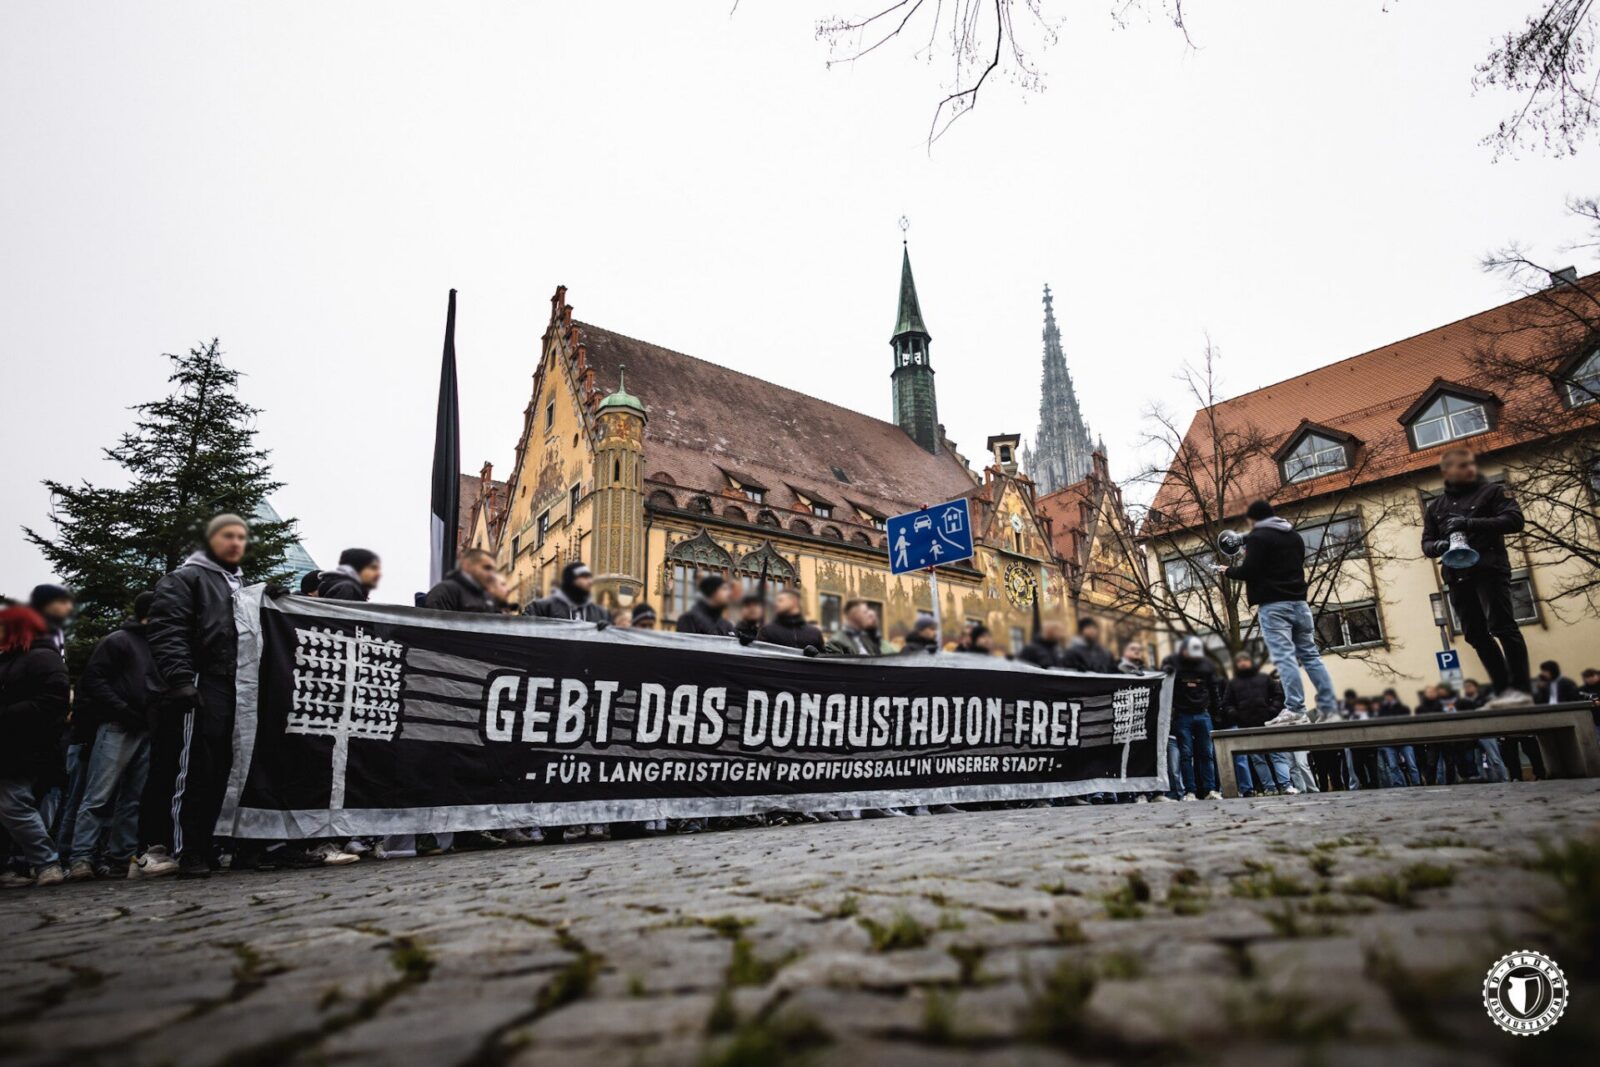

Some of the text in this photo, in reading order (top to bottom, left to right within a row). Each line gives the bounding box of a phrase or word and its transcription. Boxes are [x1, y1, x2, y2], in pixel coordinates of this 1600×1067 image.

[1440, 653, 1454, 668] P
[485, 675, 1082, 747] GEBT DAS DONAUSTADION FREI
[545, 754, 591, 784] FÜR
[599, 761, 772, 783] LANGFRISTIGEN
[776, 760, 912, 781] PROFIFUSSBALL
[916, 758, 931, 776] IN
[936, 756, 999, 774] UNSERER
